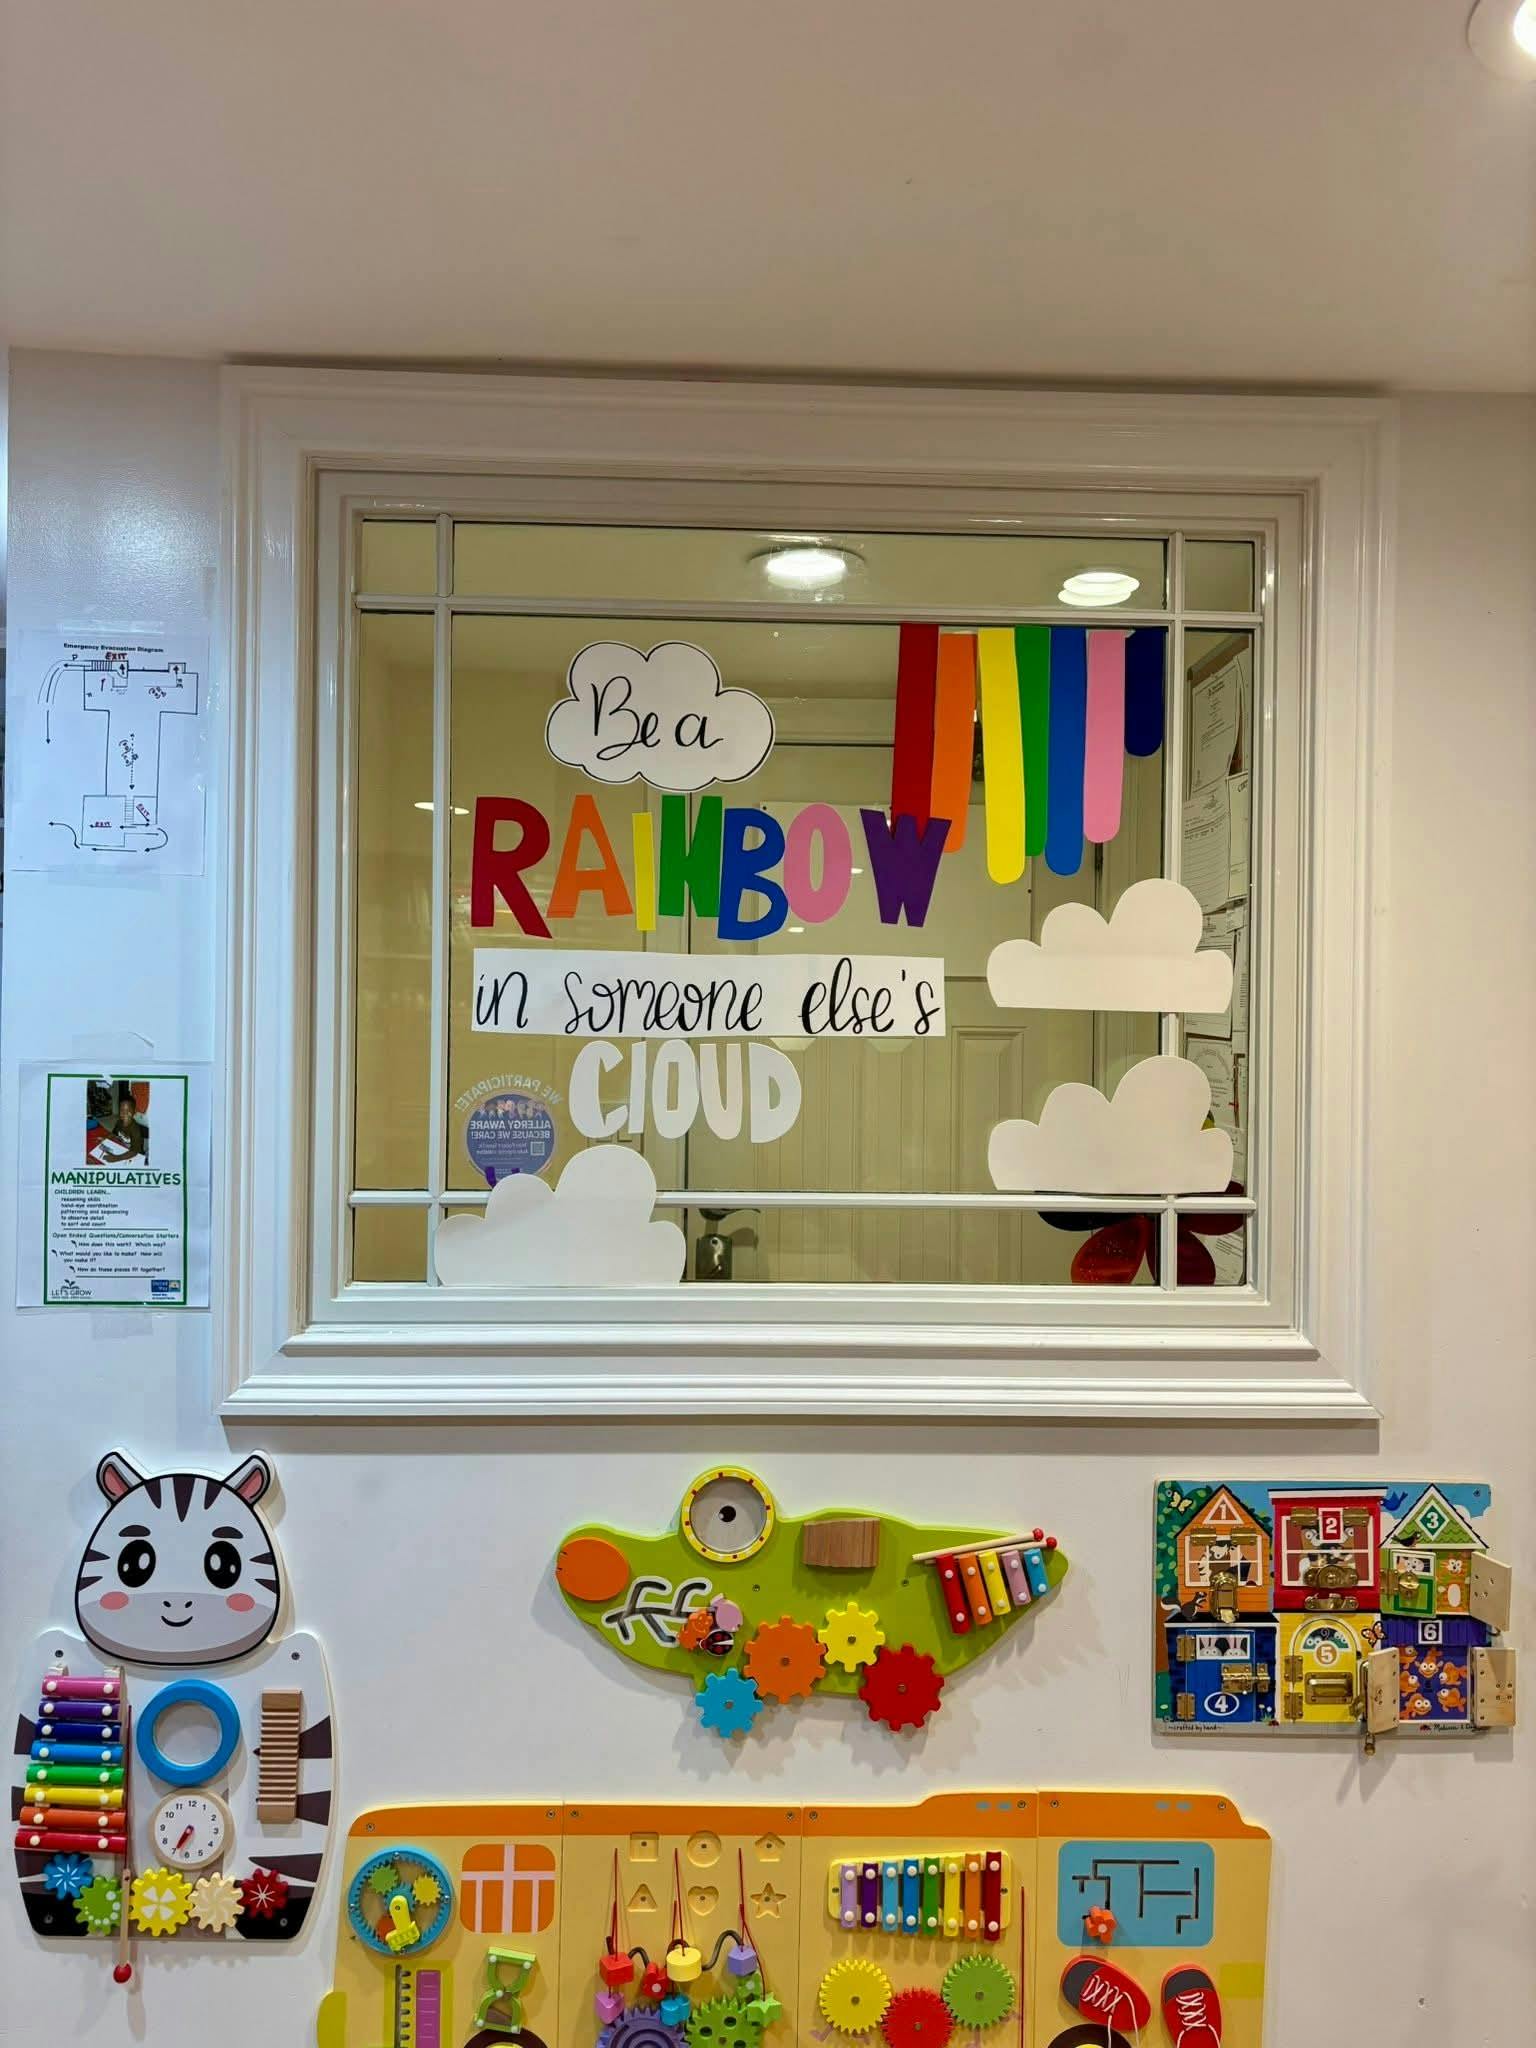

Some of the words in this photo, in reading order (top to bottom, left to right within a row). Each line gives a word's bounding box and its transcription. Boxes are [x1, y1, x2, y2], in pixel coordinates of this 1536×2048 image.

[63, 642, 99, 651] Emergency
[105, 652, 128, 661] EXIT
[591, 676, 660, 761] Be
[674, 712, 724, 750] a
[470, 794, 952, 941] RAINBOW
[476, 971, 529, 1029] in
[564, 971, 763, 1034] someone
[799, 957, 940, 1036] else's
[51, 1171, 181, 1186] MANIPULATIVES
[1219, 1498, 1228, 1521] 1
[1325, 1517, 1338, 1535] 2
[1426, 1511, 1439, 1529] 3
[1424, 1623, 1437, 1640] 6
[1321, 1646, 1334, 1662] 5
[1214, 1696, 1229, 1713] 4
[213, 1827, 219, 1835] 3
[162, 1837, 168, 1845] 8
[171, 1847, 177, 1855] 7
[198, 1849, 203, 1857] 5
